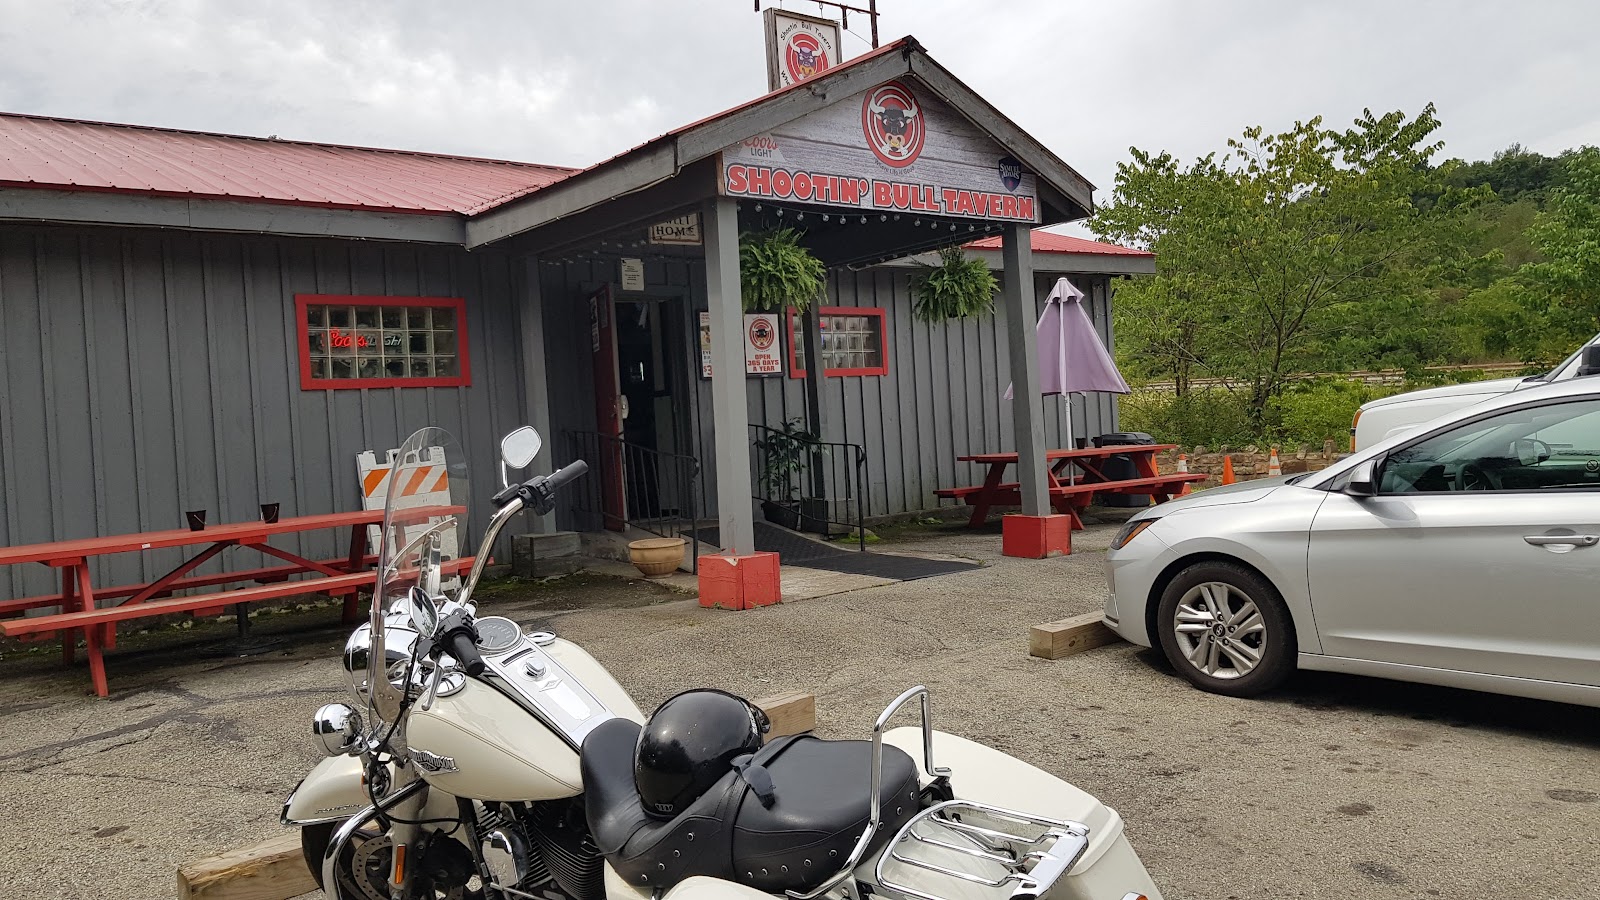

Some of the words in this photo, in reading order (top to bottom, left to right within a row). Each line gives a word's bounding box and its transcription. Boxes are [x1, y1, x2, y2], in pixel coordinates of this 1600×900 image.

[801, 21, 812, 31] Bull
[815, 27, 831, 50] Tavern
[751, 148, 772, 158] LIGHT
[727, 163, 869, 206] SHOOTIN'
[872, 179, 941, 213] BULL
[941, 187, 1034, 221] TAVERN
[656, 226, 696, 236] HOME
